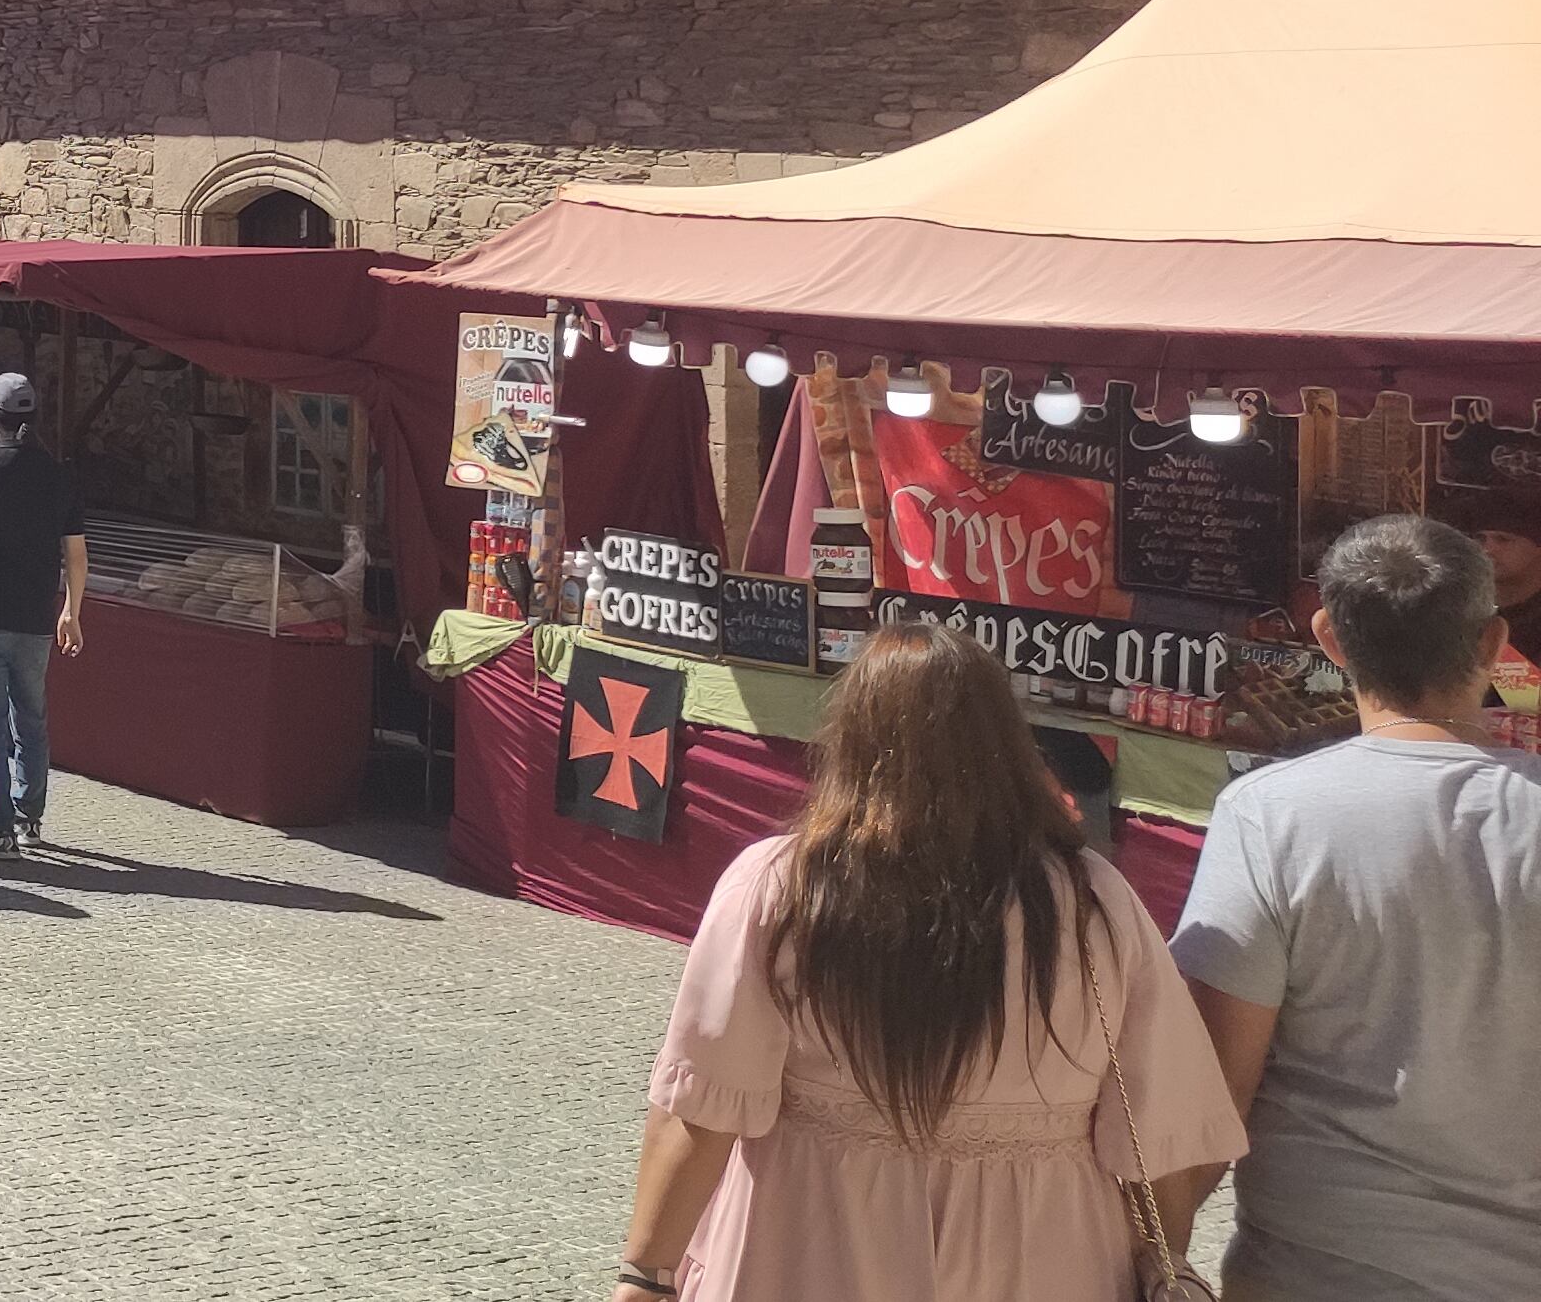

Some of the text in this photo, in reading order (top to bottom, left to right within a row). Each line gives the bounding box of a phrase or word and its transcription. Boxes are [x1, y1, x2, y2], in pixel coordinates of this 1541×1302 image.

[462, 319, 550, 355] CRÊPES
[496, 383, 552, 404] nutella
[602, 535, 718, 588] CREPES
[813, 547, 855, 559] nutella
[889, 485, 1102, 605] Crêpes
[601, 587, 718, 641] GOFRES
